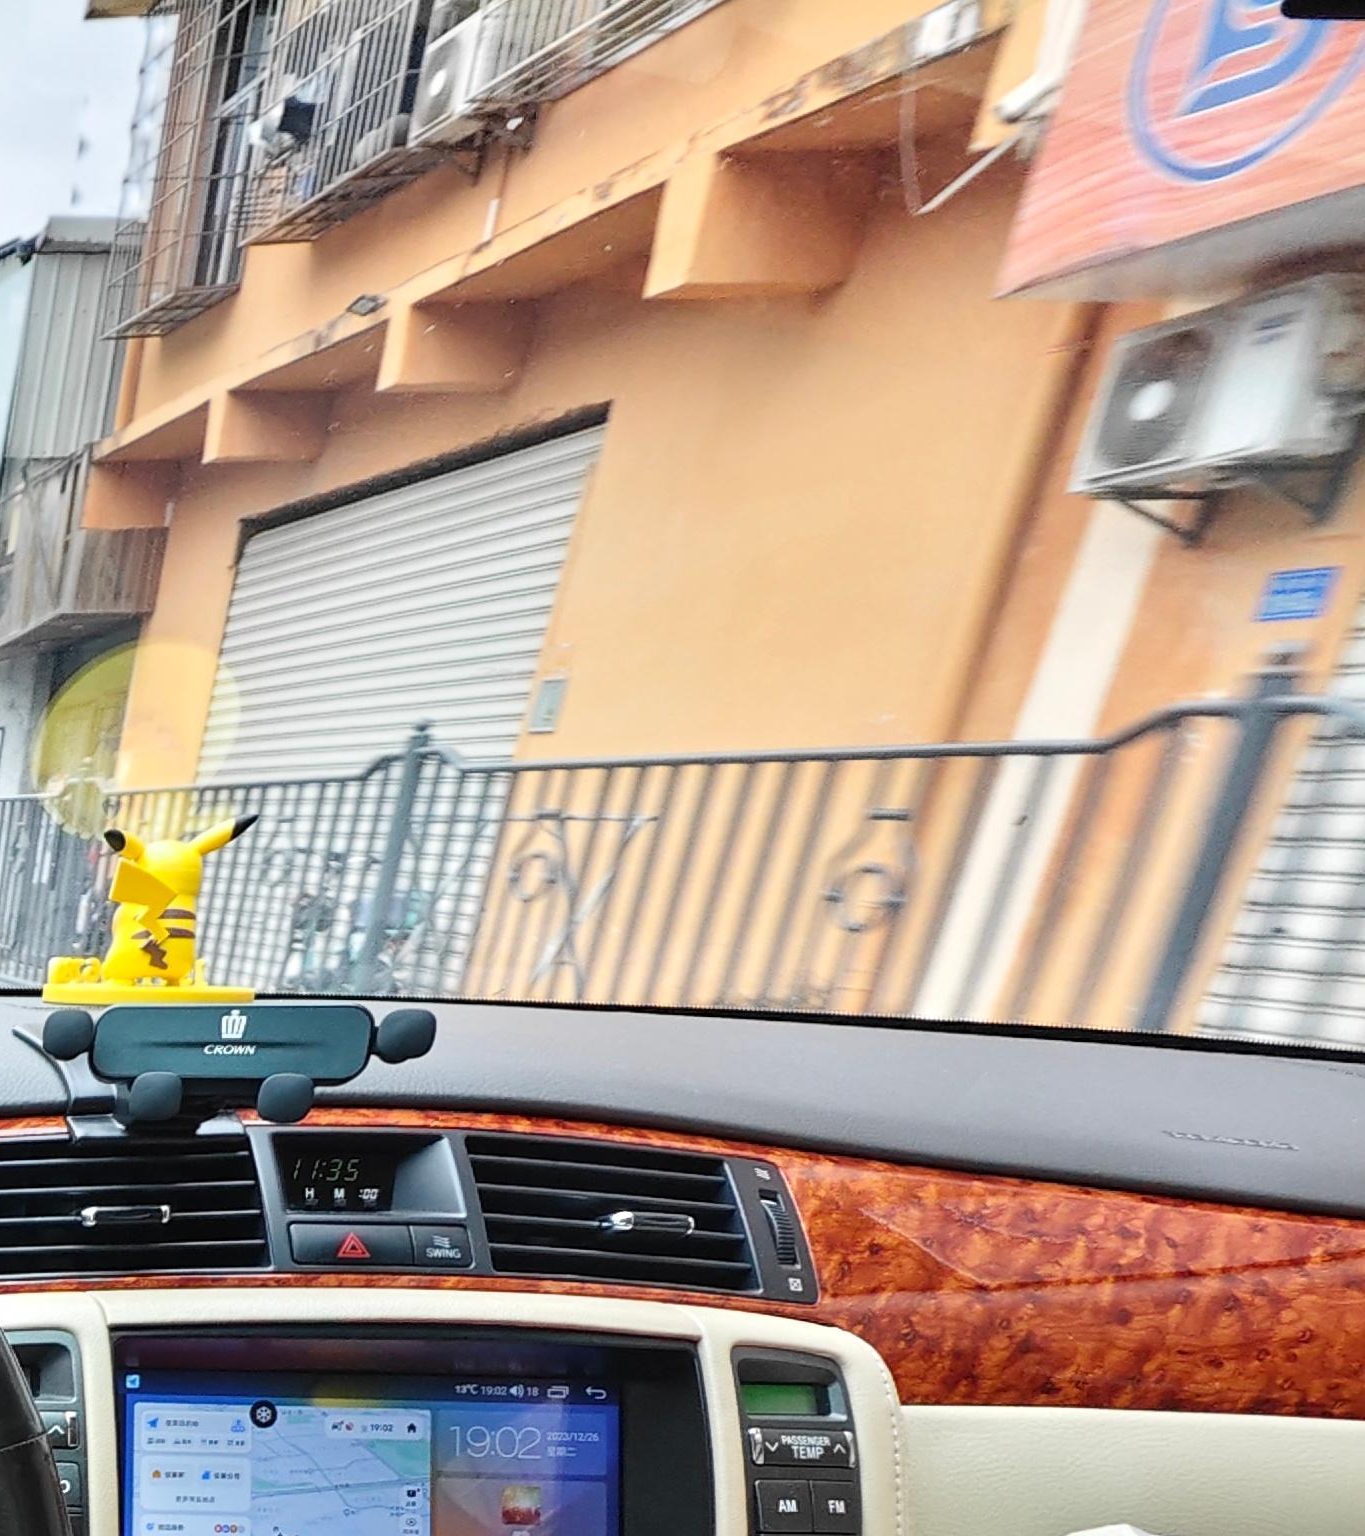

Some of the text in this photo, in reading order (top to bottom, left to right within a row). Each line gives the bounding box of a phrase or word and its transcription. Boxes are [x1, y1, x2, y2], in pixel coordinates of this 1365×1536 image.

[203, 1045, 257, 1056] CROWN
[293, 1158, 360, 1182] 11:35
[305, 1187, 315, 1200] H
[334, 1188, 345, 1199] M
[426, 1247, 461, 1260] SWING
[481, 1386, 508, 1397] 19:02
[370, 1424, 394, 1433] 19:02
[450, 1426, 600, 1460] 19:02 2023/12/26
[781, 1435, 831, 1446] PASSENGER
[791, 1446, 824, 1460] TEMP
[778, 1499, 799, 1513] AM
[828, 1499, 846, 1514] FM
